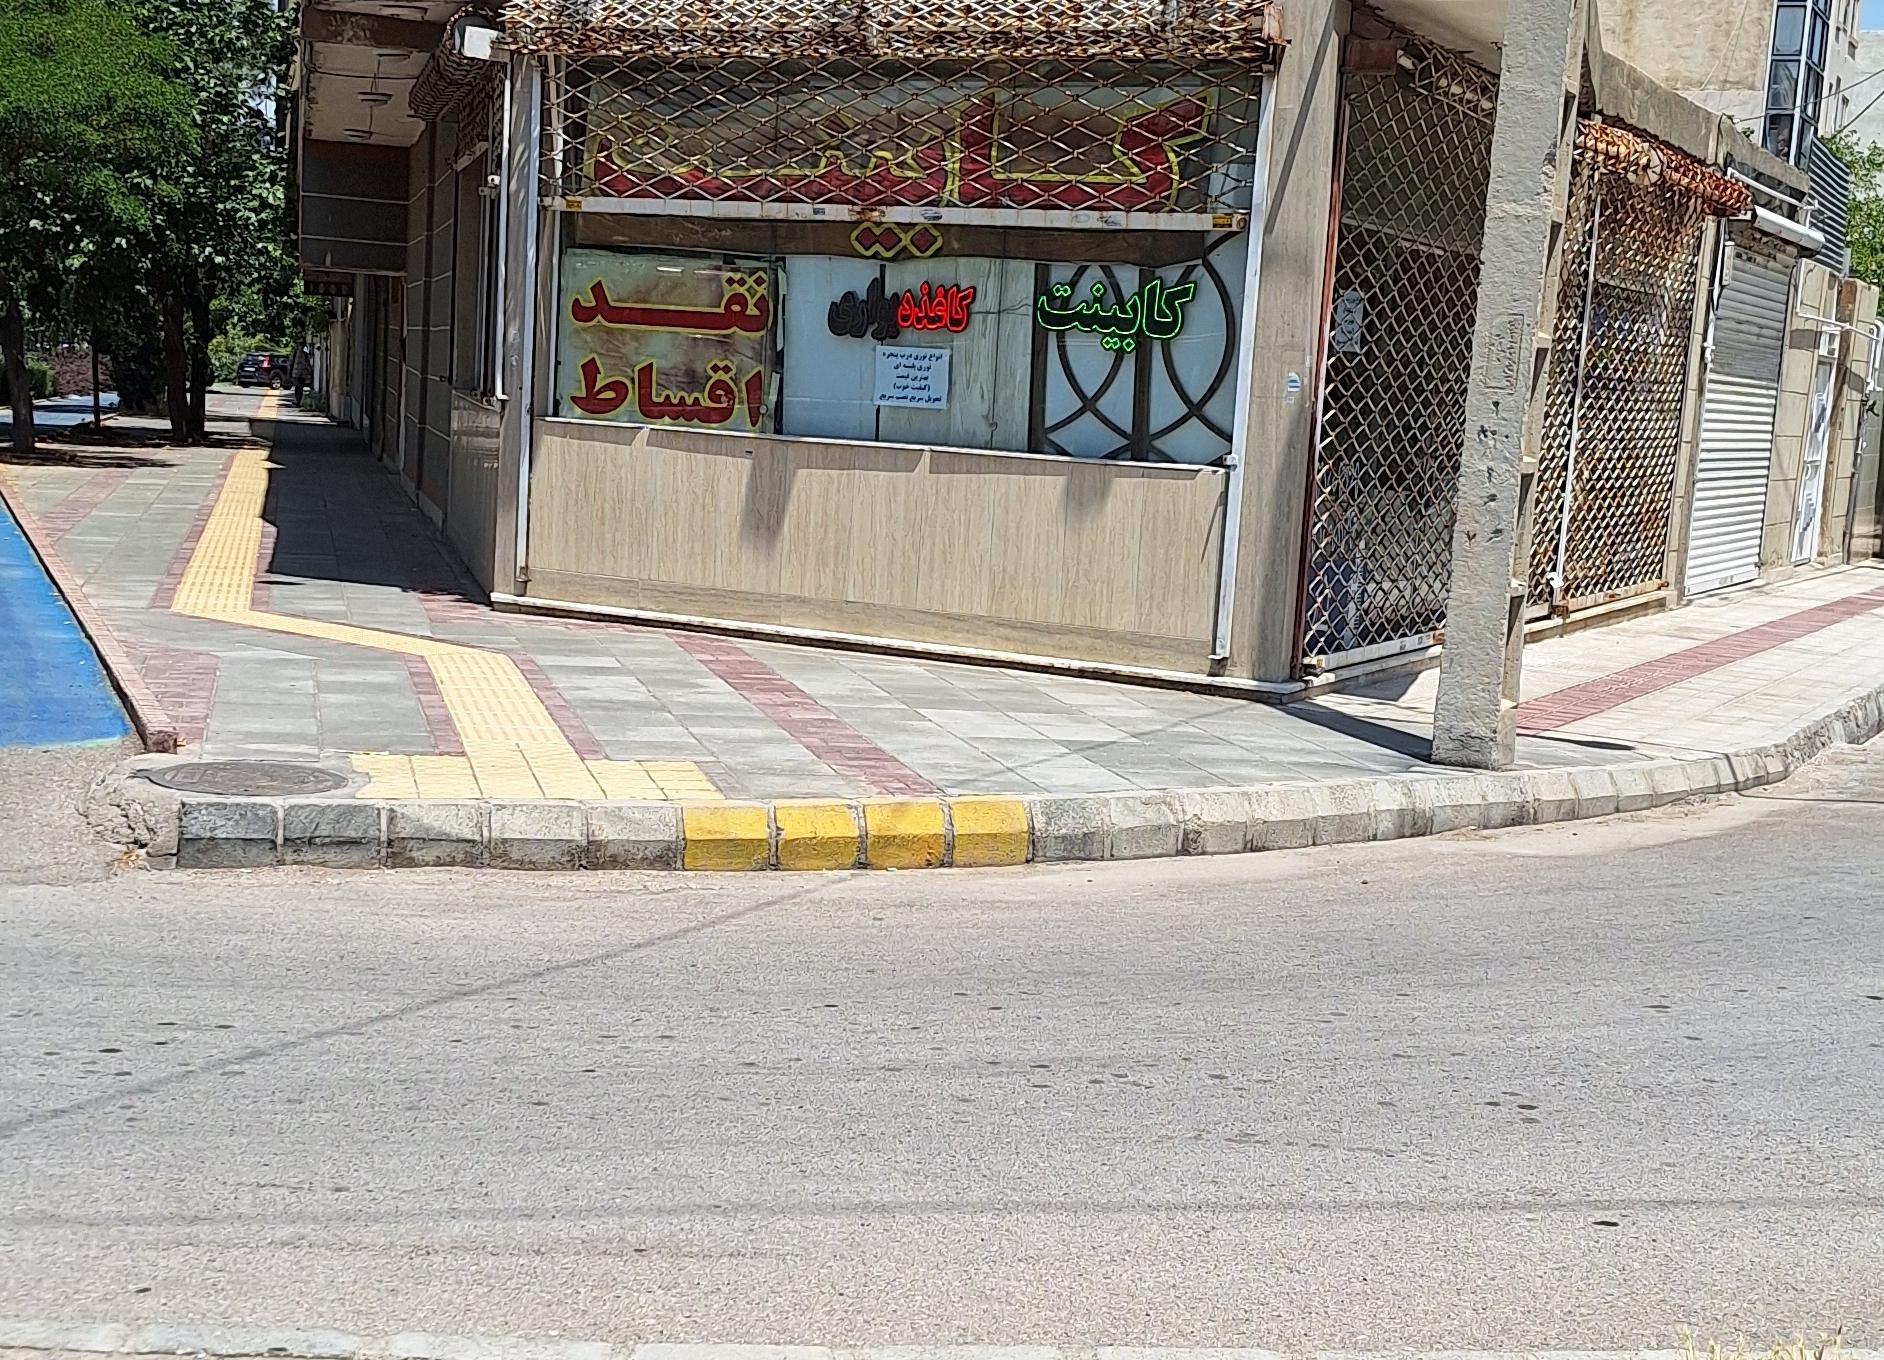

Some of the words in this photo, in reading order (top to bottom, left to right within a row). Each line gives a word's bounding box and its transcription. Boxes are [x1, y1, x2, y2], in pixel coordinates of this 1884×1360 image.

[570, 273, 773, 335] نقد
[914, 281, 977, 333] کاغذ
[1037, 277, 1197, 353] کابینت
[569, 354, 766, 428] اقساط
